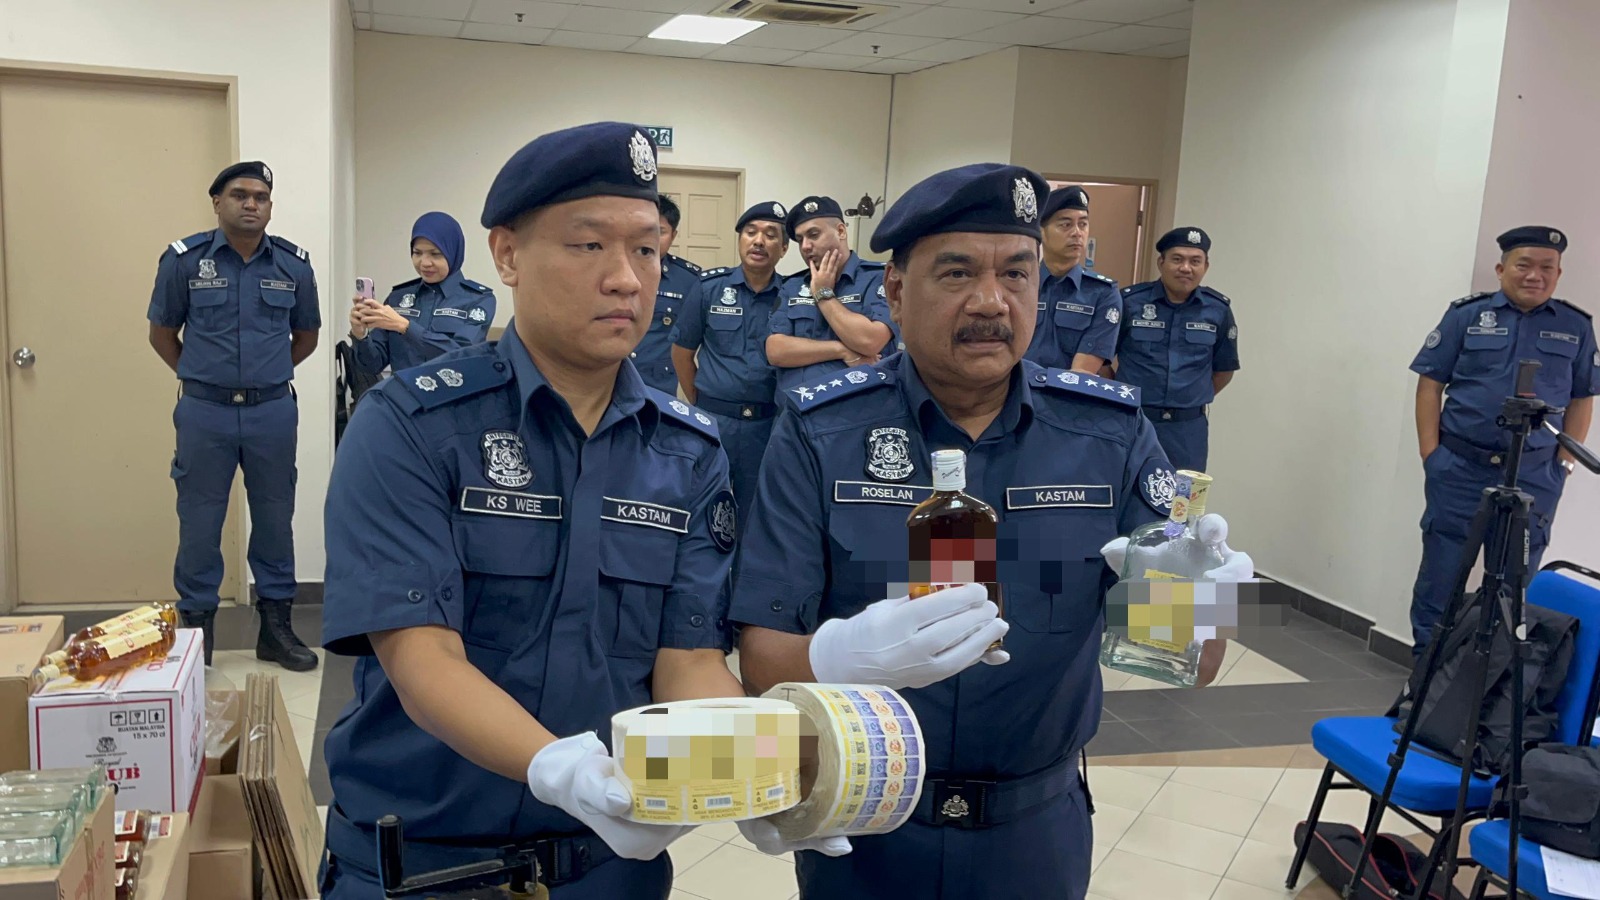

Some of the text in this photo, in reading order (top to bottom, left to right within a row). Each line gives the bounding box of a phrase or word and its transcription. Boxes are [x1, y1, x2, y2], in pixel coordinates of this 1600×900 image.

[498, 475, 530, 485] KASTAM
[875, 469, 908, 478] KASTAM
[861, 486, 913, 500] ROSELAN
[1035, 490, 1086, 502] KASTAM
[486, 494, 542, 513] KS WEE
[617, 504, 671, 525] KASTAM
[107, 767, 140, 781] UB
